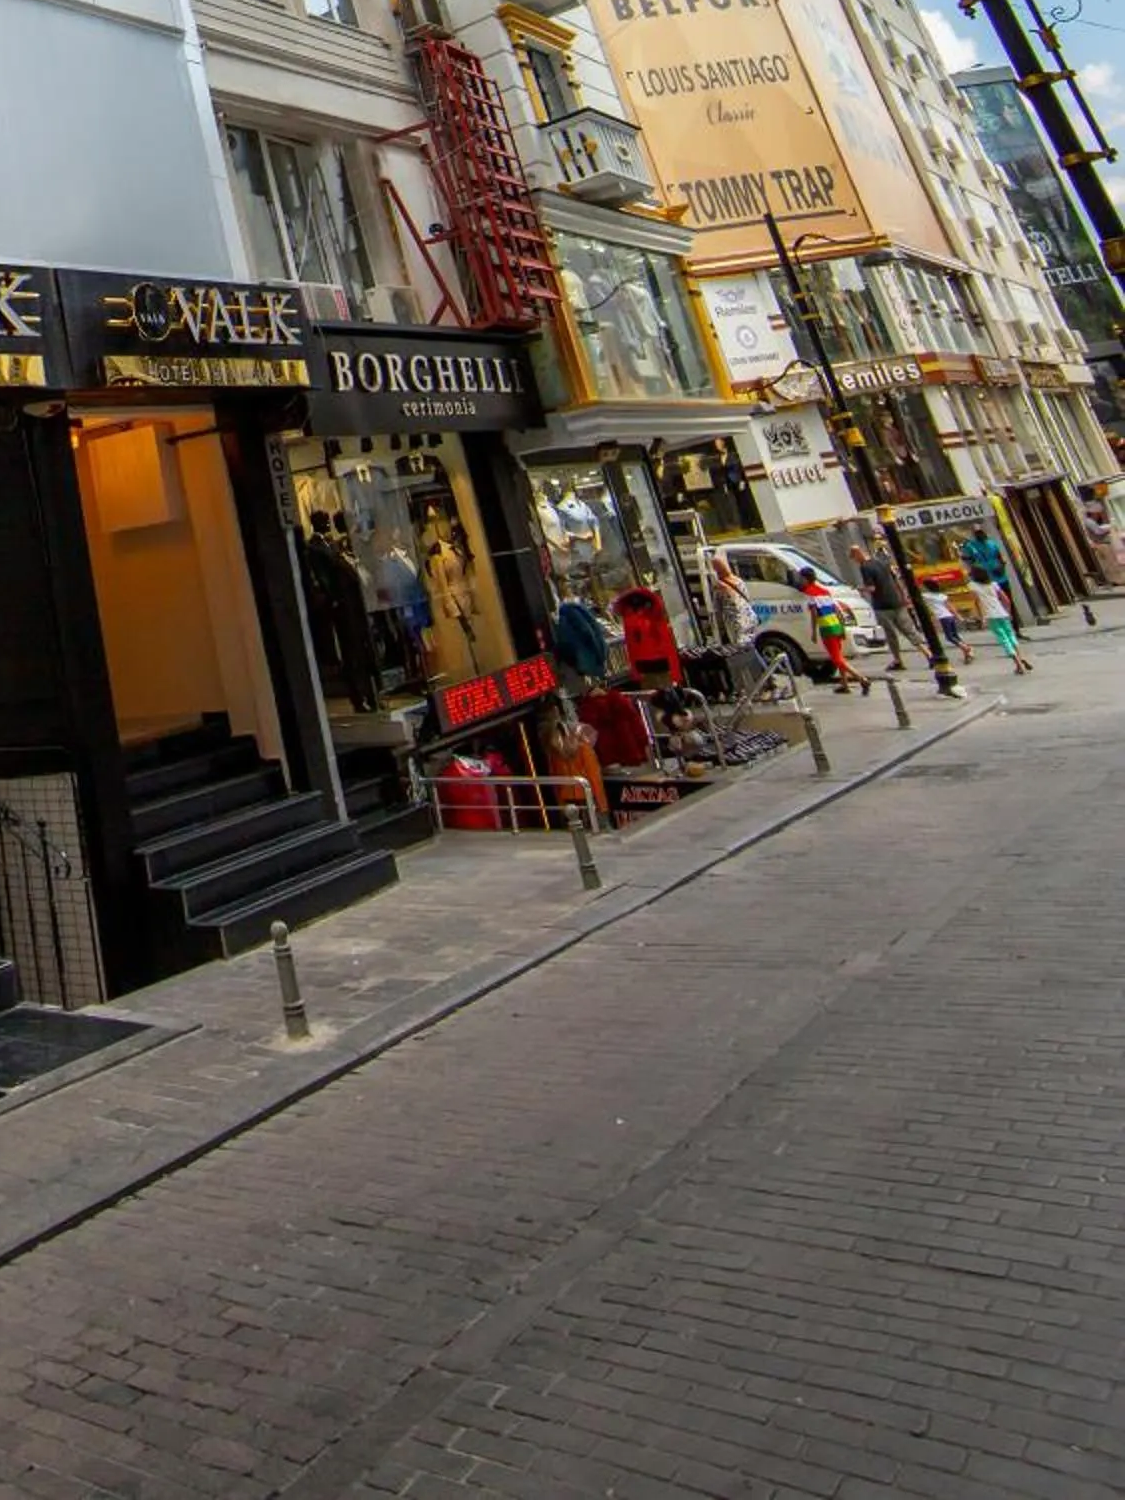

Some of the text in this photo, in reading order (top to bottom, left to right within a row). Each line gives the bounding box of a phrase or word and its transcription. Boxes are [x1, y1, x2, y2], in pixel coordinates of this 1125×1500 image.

[637, 55, 790, 97] LOUIS SANTIAGO
[678, 165, 836, 223] TOMMY TRAP
[172, 287, 303, 346] VALK
[402, 398, 476, 417] cerimonia
[269, 439, 294, 526] HOTEL
